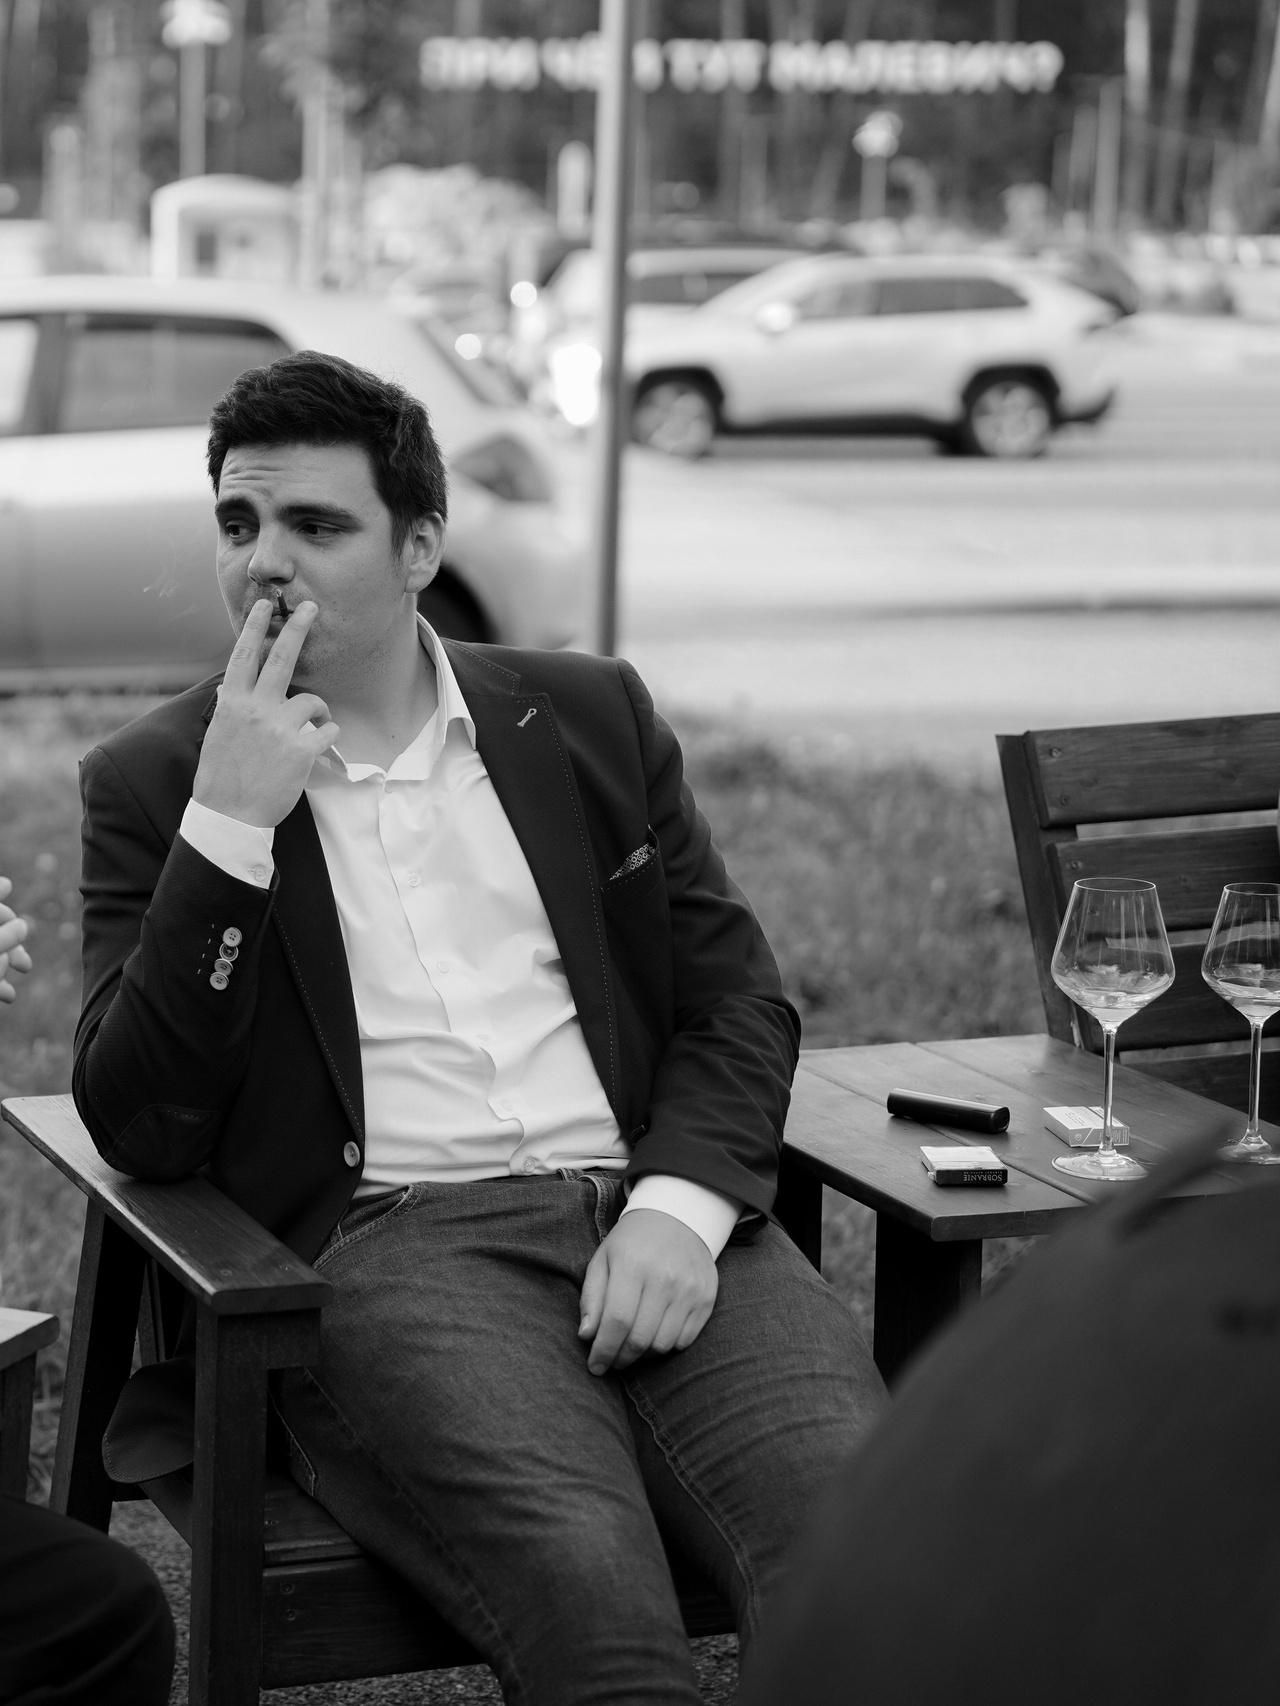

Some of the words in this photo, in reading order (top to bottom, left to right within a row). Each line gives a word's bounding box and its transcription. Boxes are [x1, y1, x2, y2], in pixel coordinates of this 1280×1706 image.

[420, 36, 540, 91] ПРИ
[664, 38, 766, 93] ТУТ
[769, 39, 1064, 93] МАЛЕВИЧ?
[963, 1174, 1003, 1182] SOBRANIE
